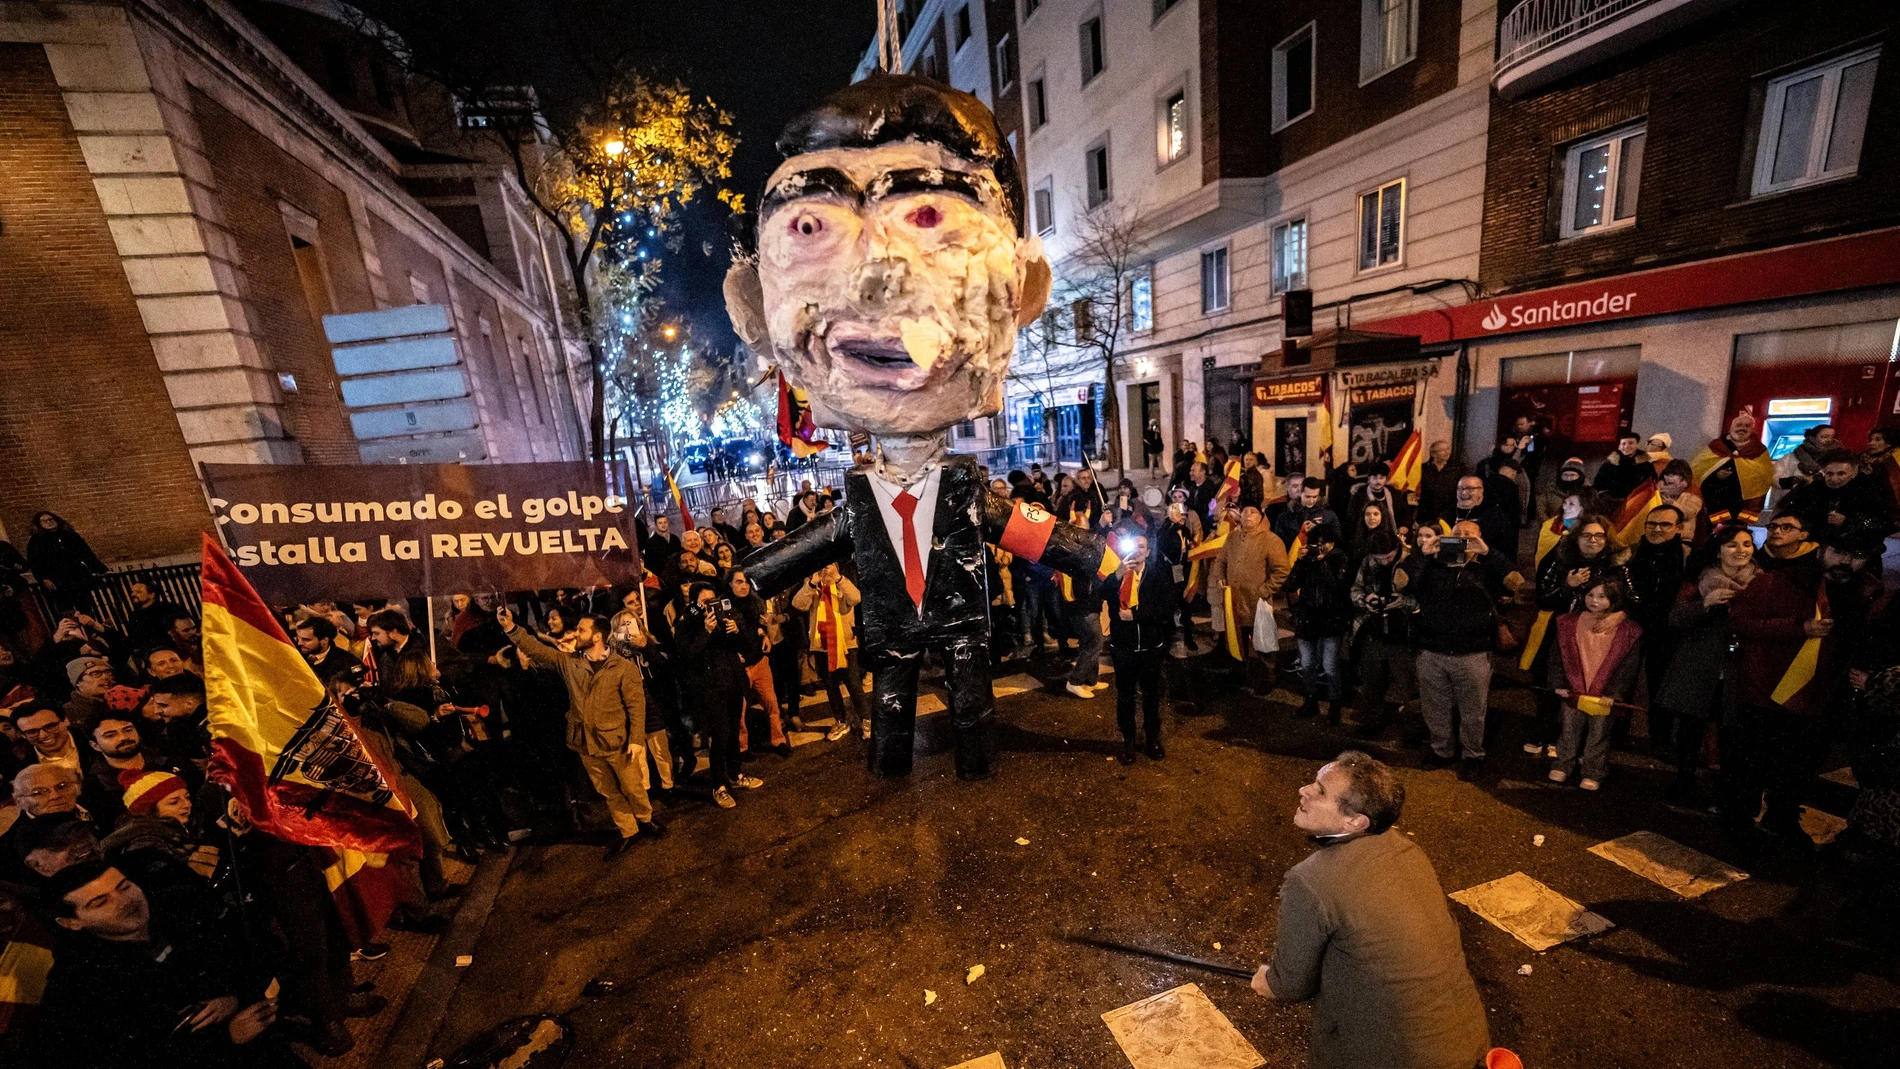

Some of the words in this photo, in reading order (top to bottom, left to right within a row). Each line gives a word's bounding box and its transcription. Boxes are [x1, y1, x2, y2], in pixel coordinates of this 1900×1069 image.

[1510, 292, 1637, 327] Santander
[1268, 380, 1316, 396] TABACOS
[1354, 367, 1418, 384] TABACALERA
[1366, 384, 1415, 401] TABACOS
[210, 493, 464, 525] Consumado
[474, 493, 513, 519] el
[522, 490, 624, 524] golpe
[380, 534, 420, 561] la
[432, 527, 628, 559] REVUELTA
